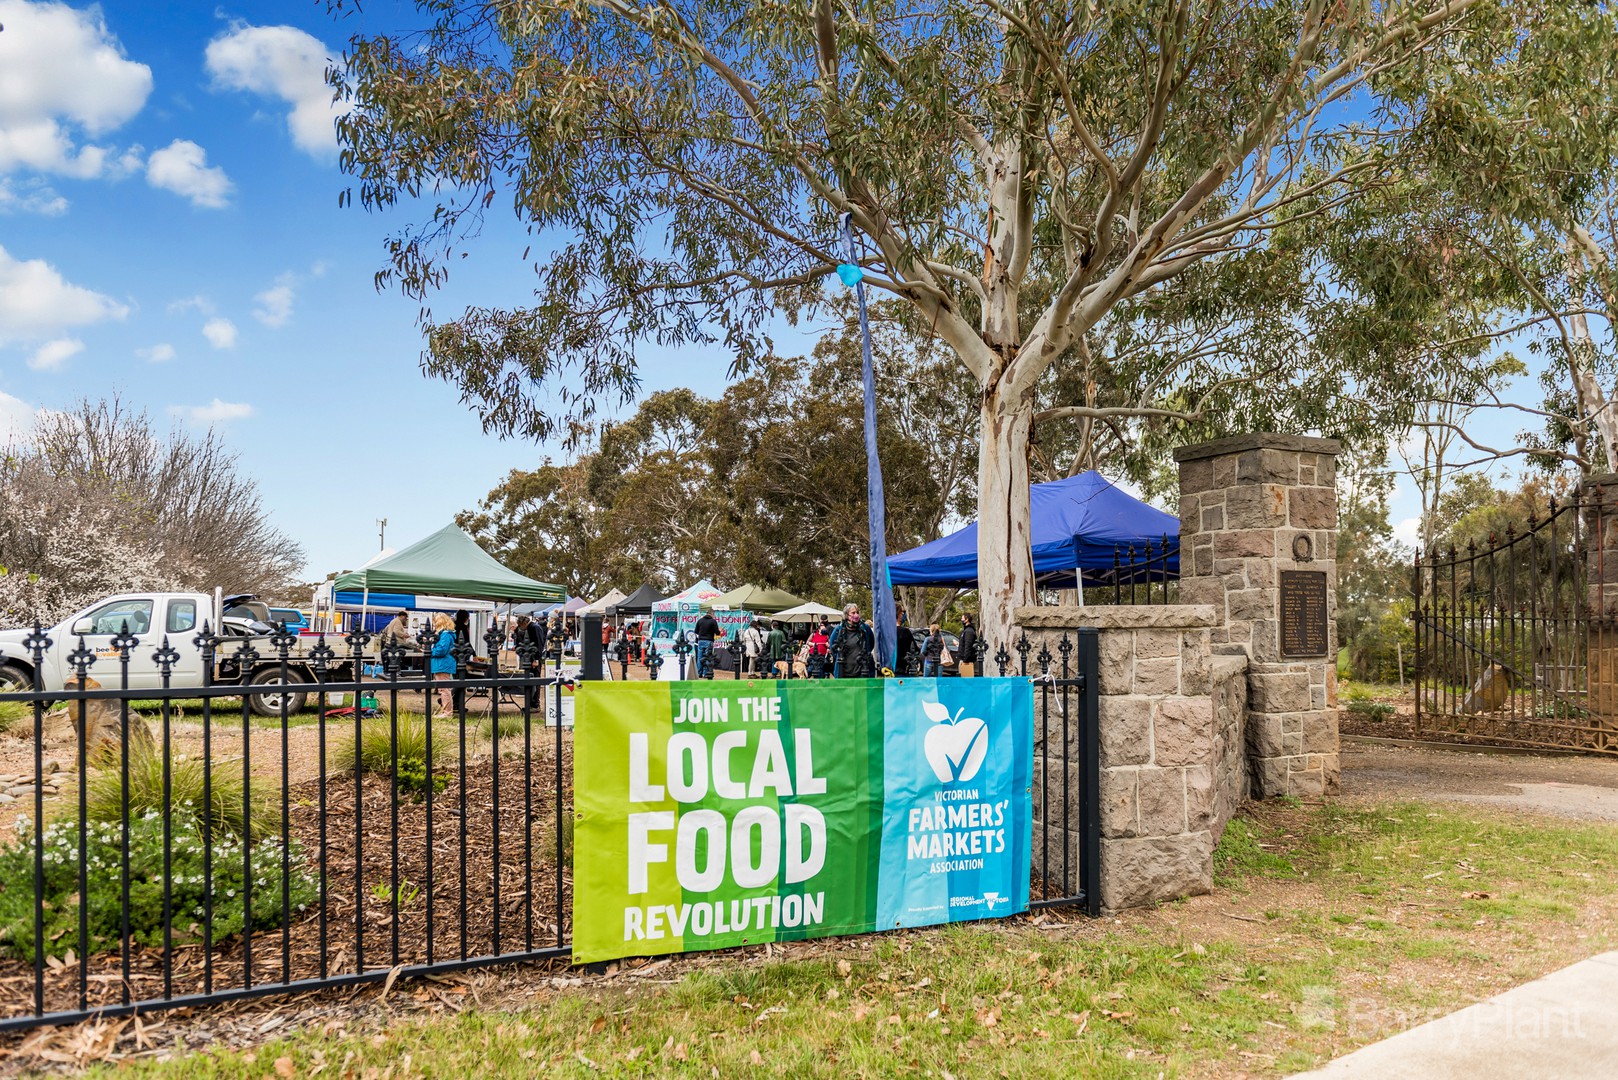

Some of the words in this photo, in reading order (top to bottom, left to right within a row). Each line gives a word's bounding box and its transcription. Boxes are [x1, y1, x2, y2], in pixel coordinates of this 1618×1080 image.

[682, 615, 697, 623] HOT
[674, 697, 728, 724] JOIN
[738, 697, 782, 721] THE
[629, 728, 827, 803] LOCAL
[935, 789, 979, 801] VICTORIAN
[908, 800, 1009, 833] FARMERS'
[628, 803, 827, 894] FOOD
[908, 828, 1005, 860] MARKETS
[930, 858, 984, 874] ASSOCIATION
[624, 891, 825, 941] REVOLUTION
[950, 898, 985, 907] DEVELOPMENT
